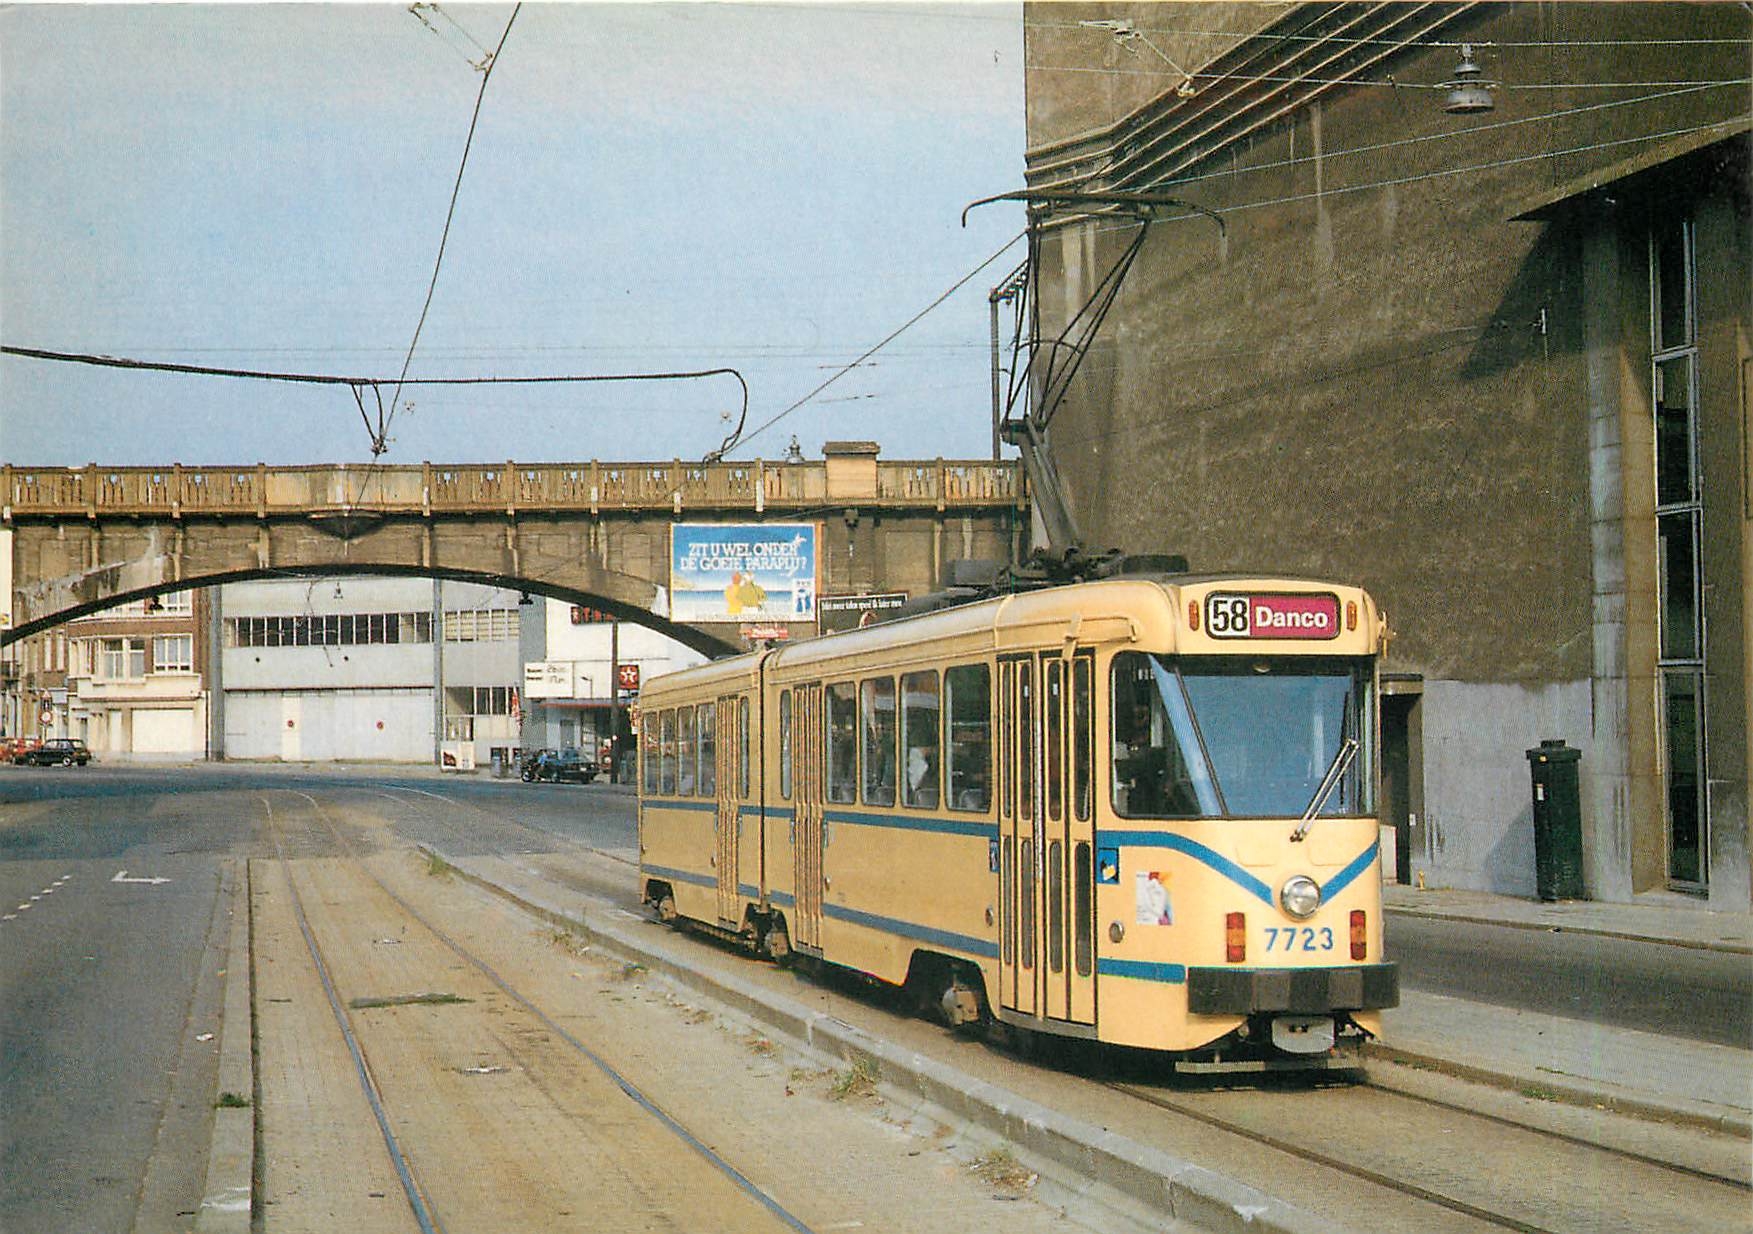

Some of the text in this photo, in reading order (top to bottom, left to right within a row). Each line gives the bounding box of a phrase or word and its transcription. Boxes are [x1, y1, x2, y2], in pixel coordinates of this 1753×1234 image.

[721, 543, 752, 557] WEL
[753, 542, 798, 557] ONDER
[680, 557, 696, 570] DE
[1212, 599, 1328, 632] 58 Danco
[1264, 927, 1334, 952] 7723
